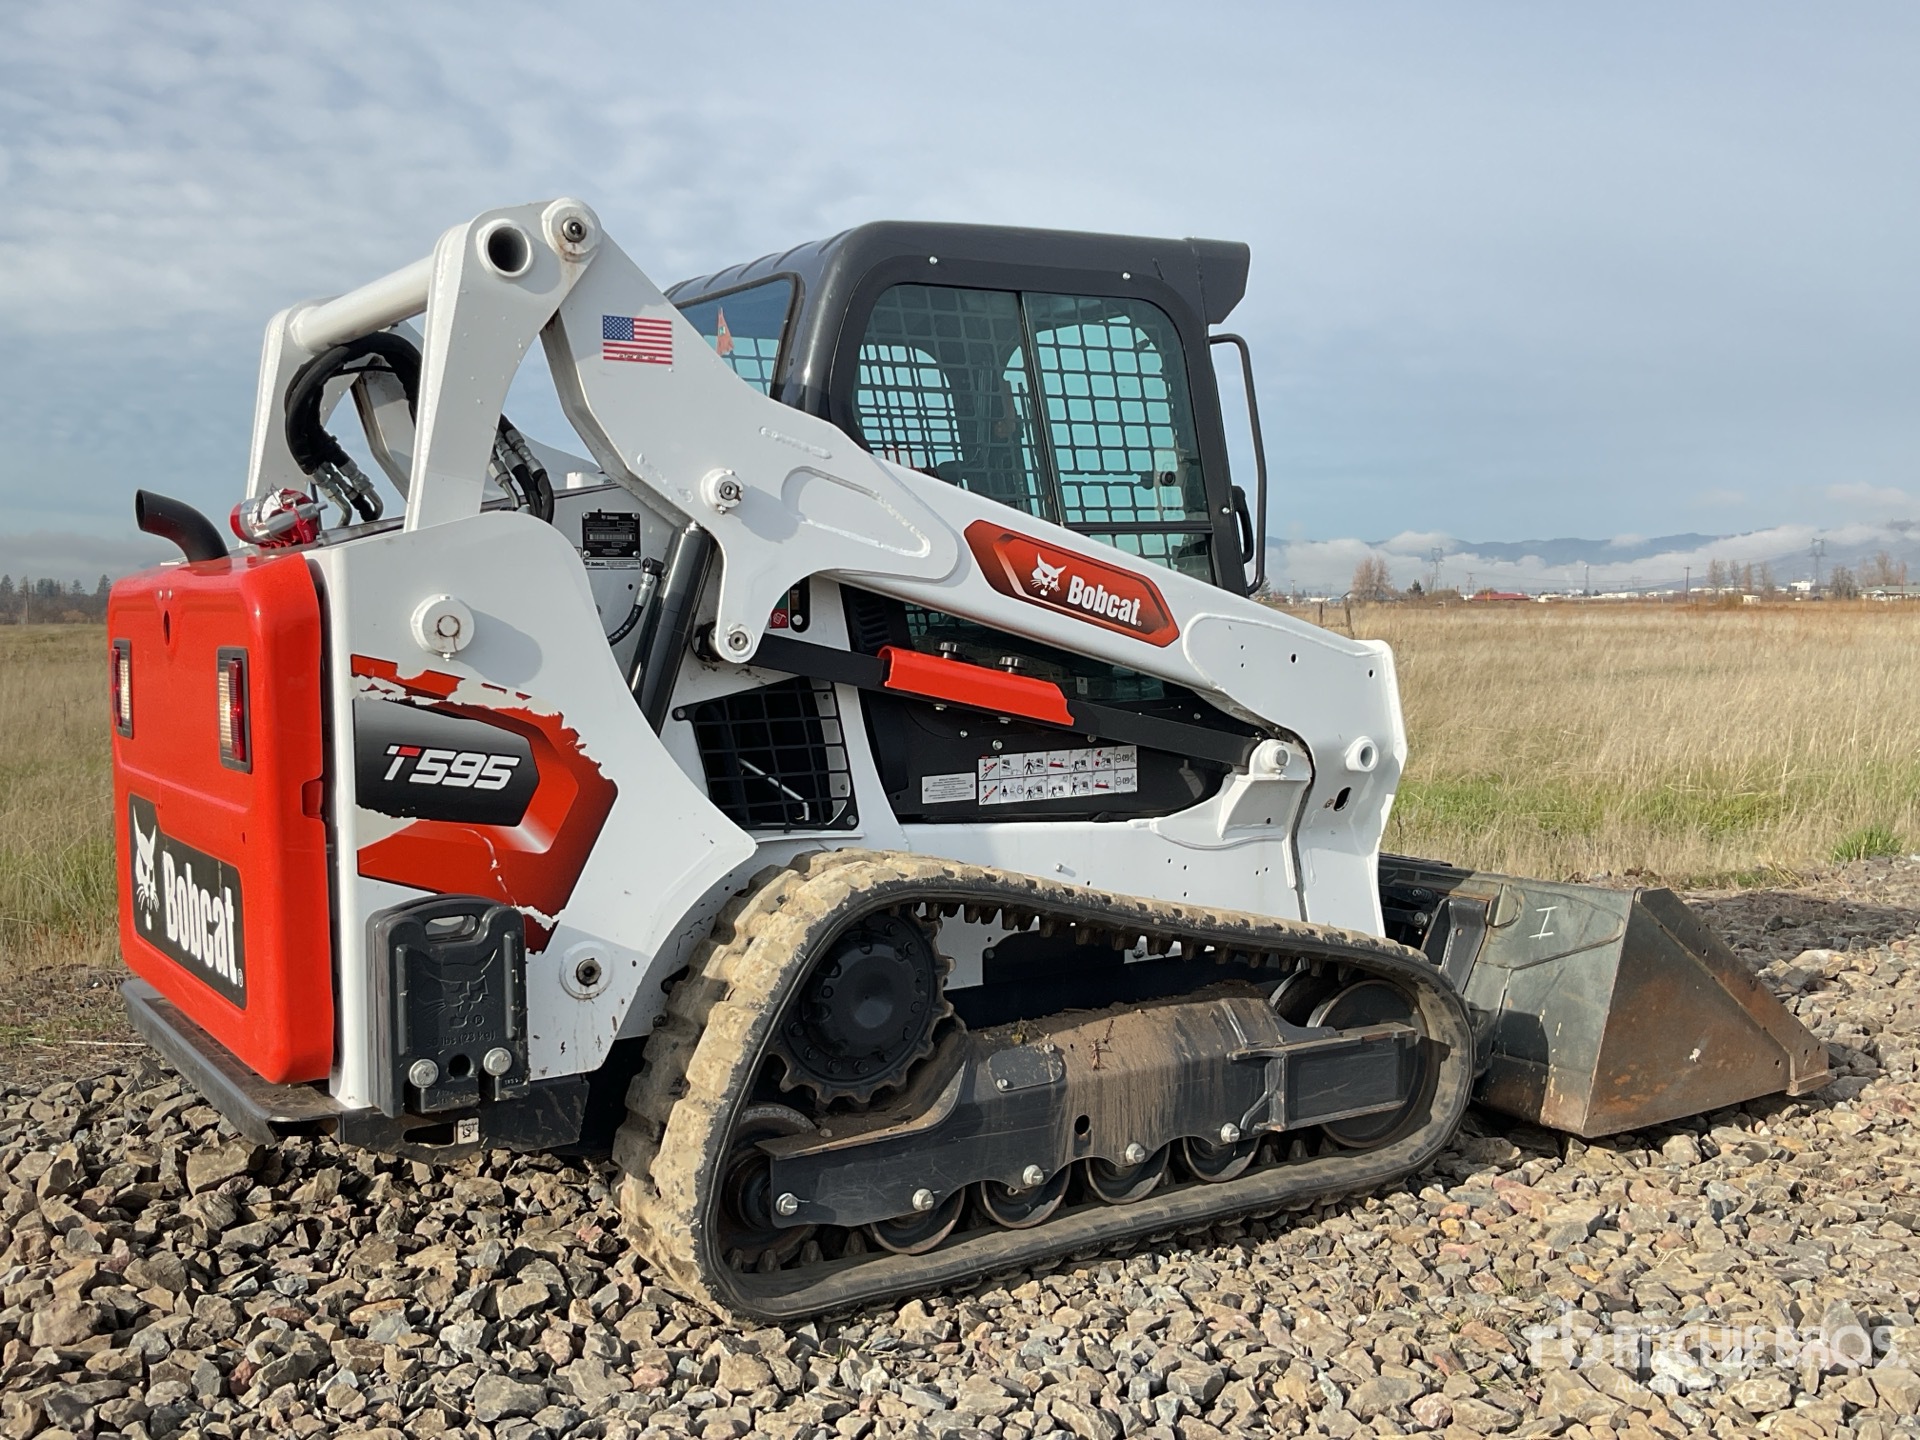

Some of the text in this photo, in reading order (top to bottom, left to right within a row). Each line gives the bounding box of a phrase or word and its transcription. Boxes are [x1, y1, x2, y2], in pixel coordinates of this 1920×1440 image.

[1067, 575, 1140, 625] Bobcat
[383, 745, 520, 791] T595
[162, 850, 238, 984] Bobcat
